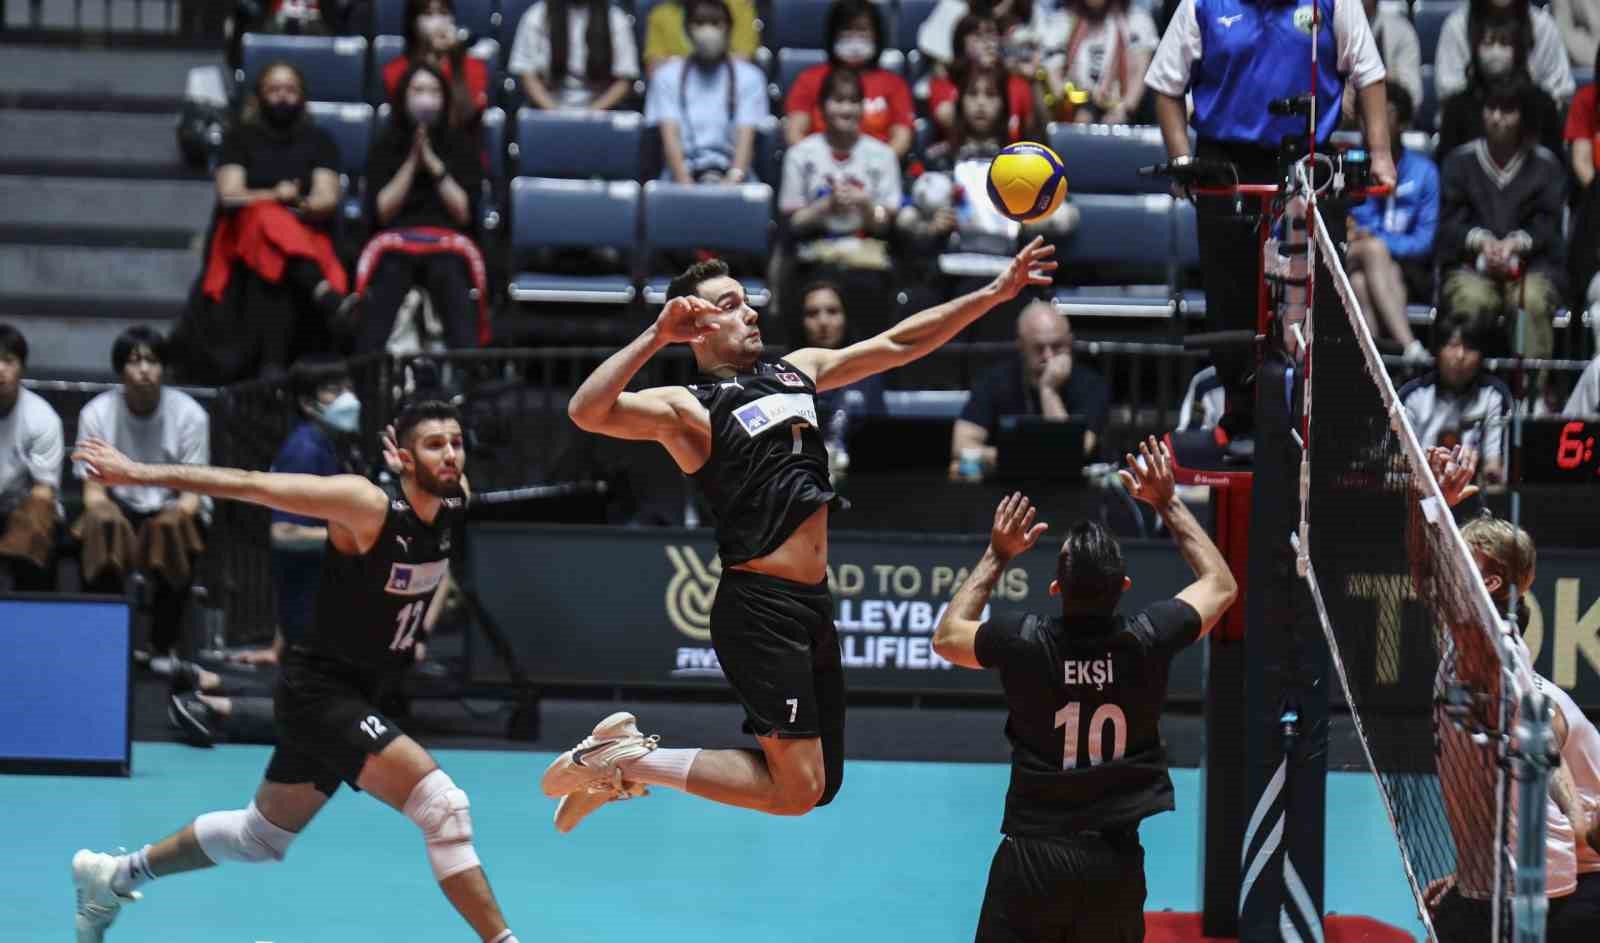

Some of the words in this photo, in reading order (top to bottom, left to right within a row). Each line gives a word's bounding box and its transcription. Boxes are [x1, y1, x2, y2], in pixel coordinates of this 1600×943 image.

[873, 564, 922, 597] TO
[931, 565, 1029, 601] PIS
[389, 600, 425, 650] 12
[1063, 652, 1114, 691] EKŞİ
[360, 715, 387, 739] 12
[785, 698, 798, 723] 7
[1054, 701, 1127, 770] 10
